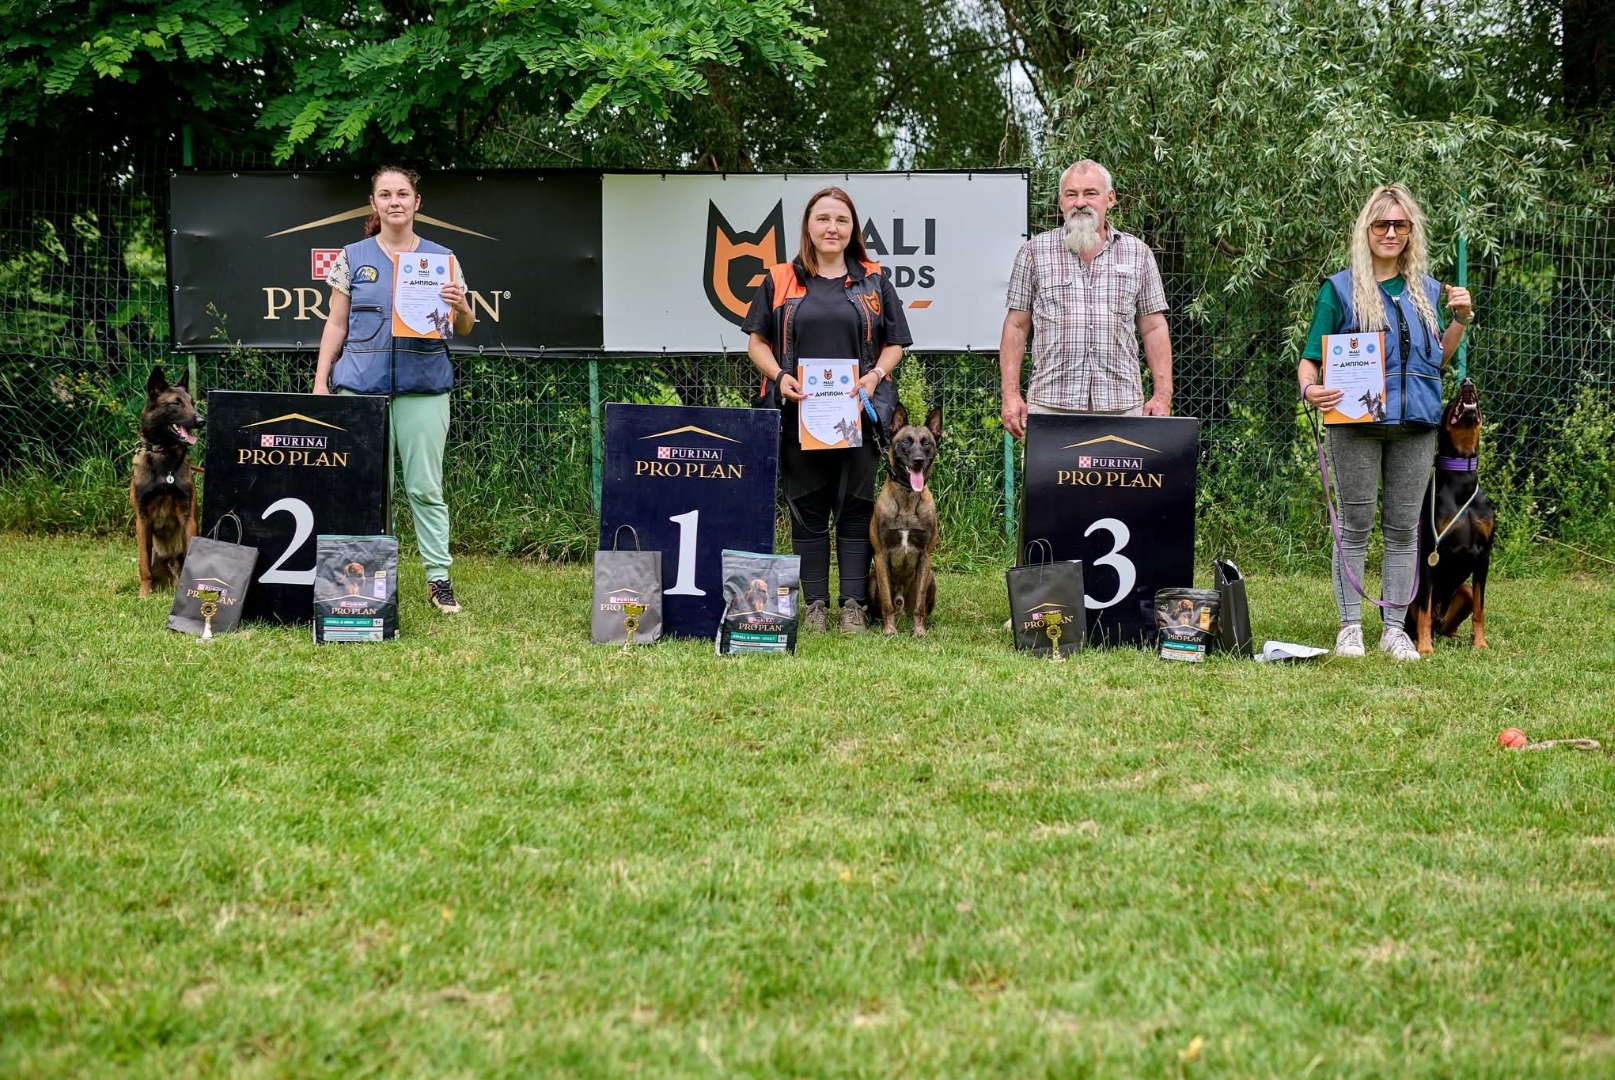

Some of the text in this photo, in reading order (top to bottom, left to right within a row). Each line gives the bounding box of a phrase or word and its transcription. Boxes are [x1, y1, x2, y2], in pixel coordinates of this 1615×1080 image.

[861, 217, 936, 255] ALI
[262, 287, 333, 320] PR
[275, 437, 324, 447] PURINA
[237, 449, 349, 467] PRO PLAN
[671, 449, 720, 459] PURINA
[1092, 457, 1140, 468] PURINA
[635, 460, 744, 479] PRO PLAN
[1057, 470, 1164, 488] PRO PLAN
[258, 497, 317, 585] 2
[663, 509, 707, 596] 1
[1083, 517, 1137, 609] 3
[331, 607, 350, 615] PRO
[600, 603, 621, 611] PRO
[738, 622, 757, 630] PRO
[1024, 620, 1045, 629] PRO
